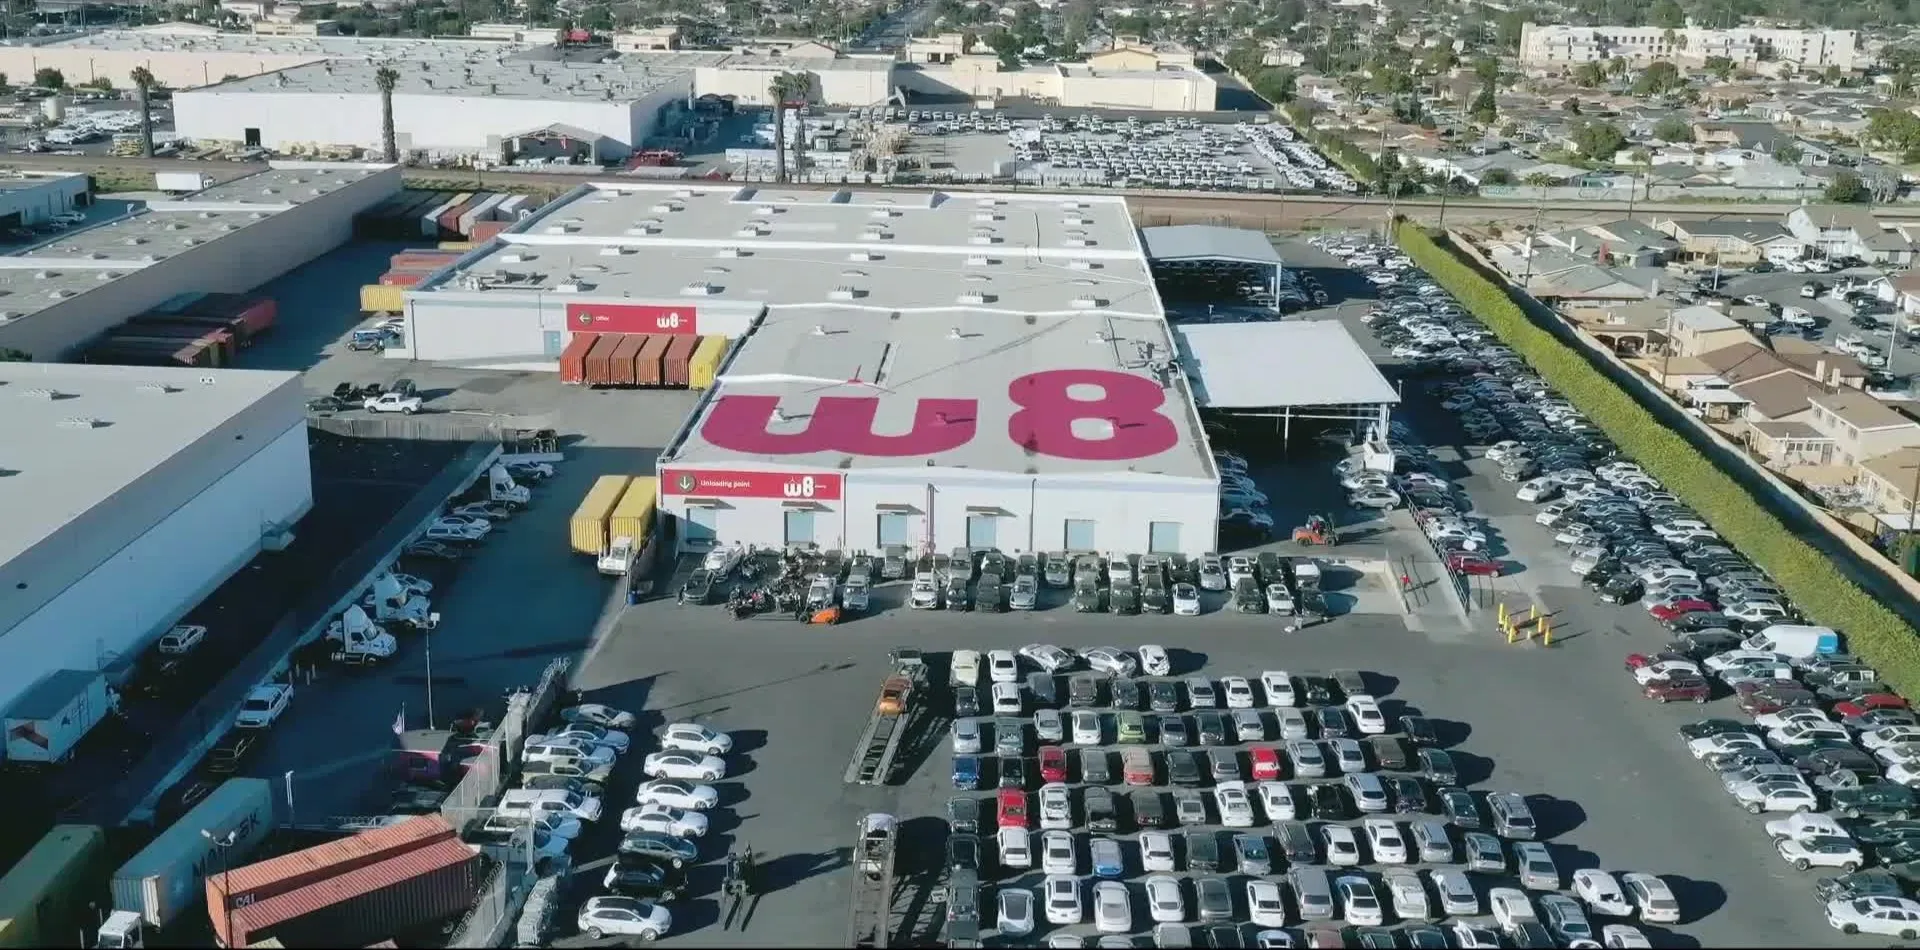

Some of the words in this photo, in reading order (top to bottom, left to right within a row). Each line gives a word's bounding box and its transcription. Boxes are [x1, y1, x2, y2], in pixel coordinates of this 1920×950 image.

[656, 312, 679, 328] w8
[700, 480, 732, 488] Unloading
[784, 476, 814, 497] w8
